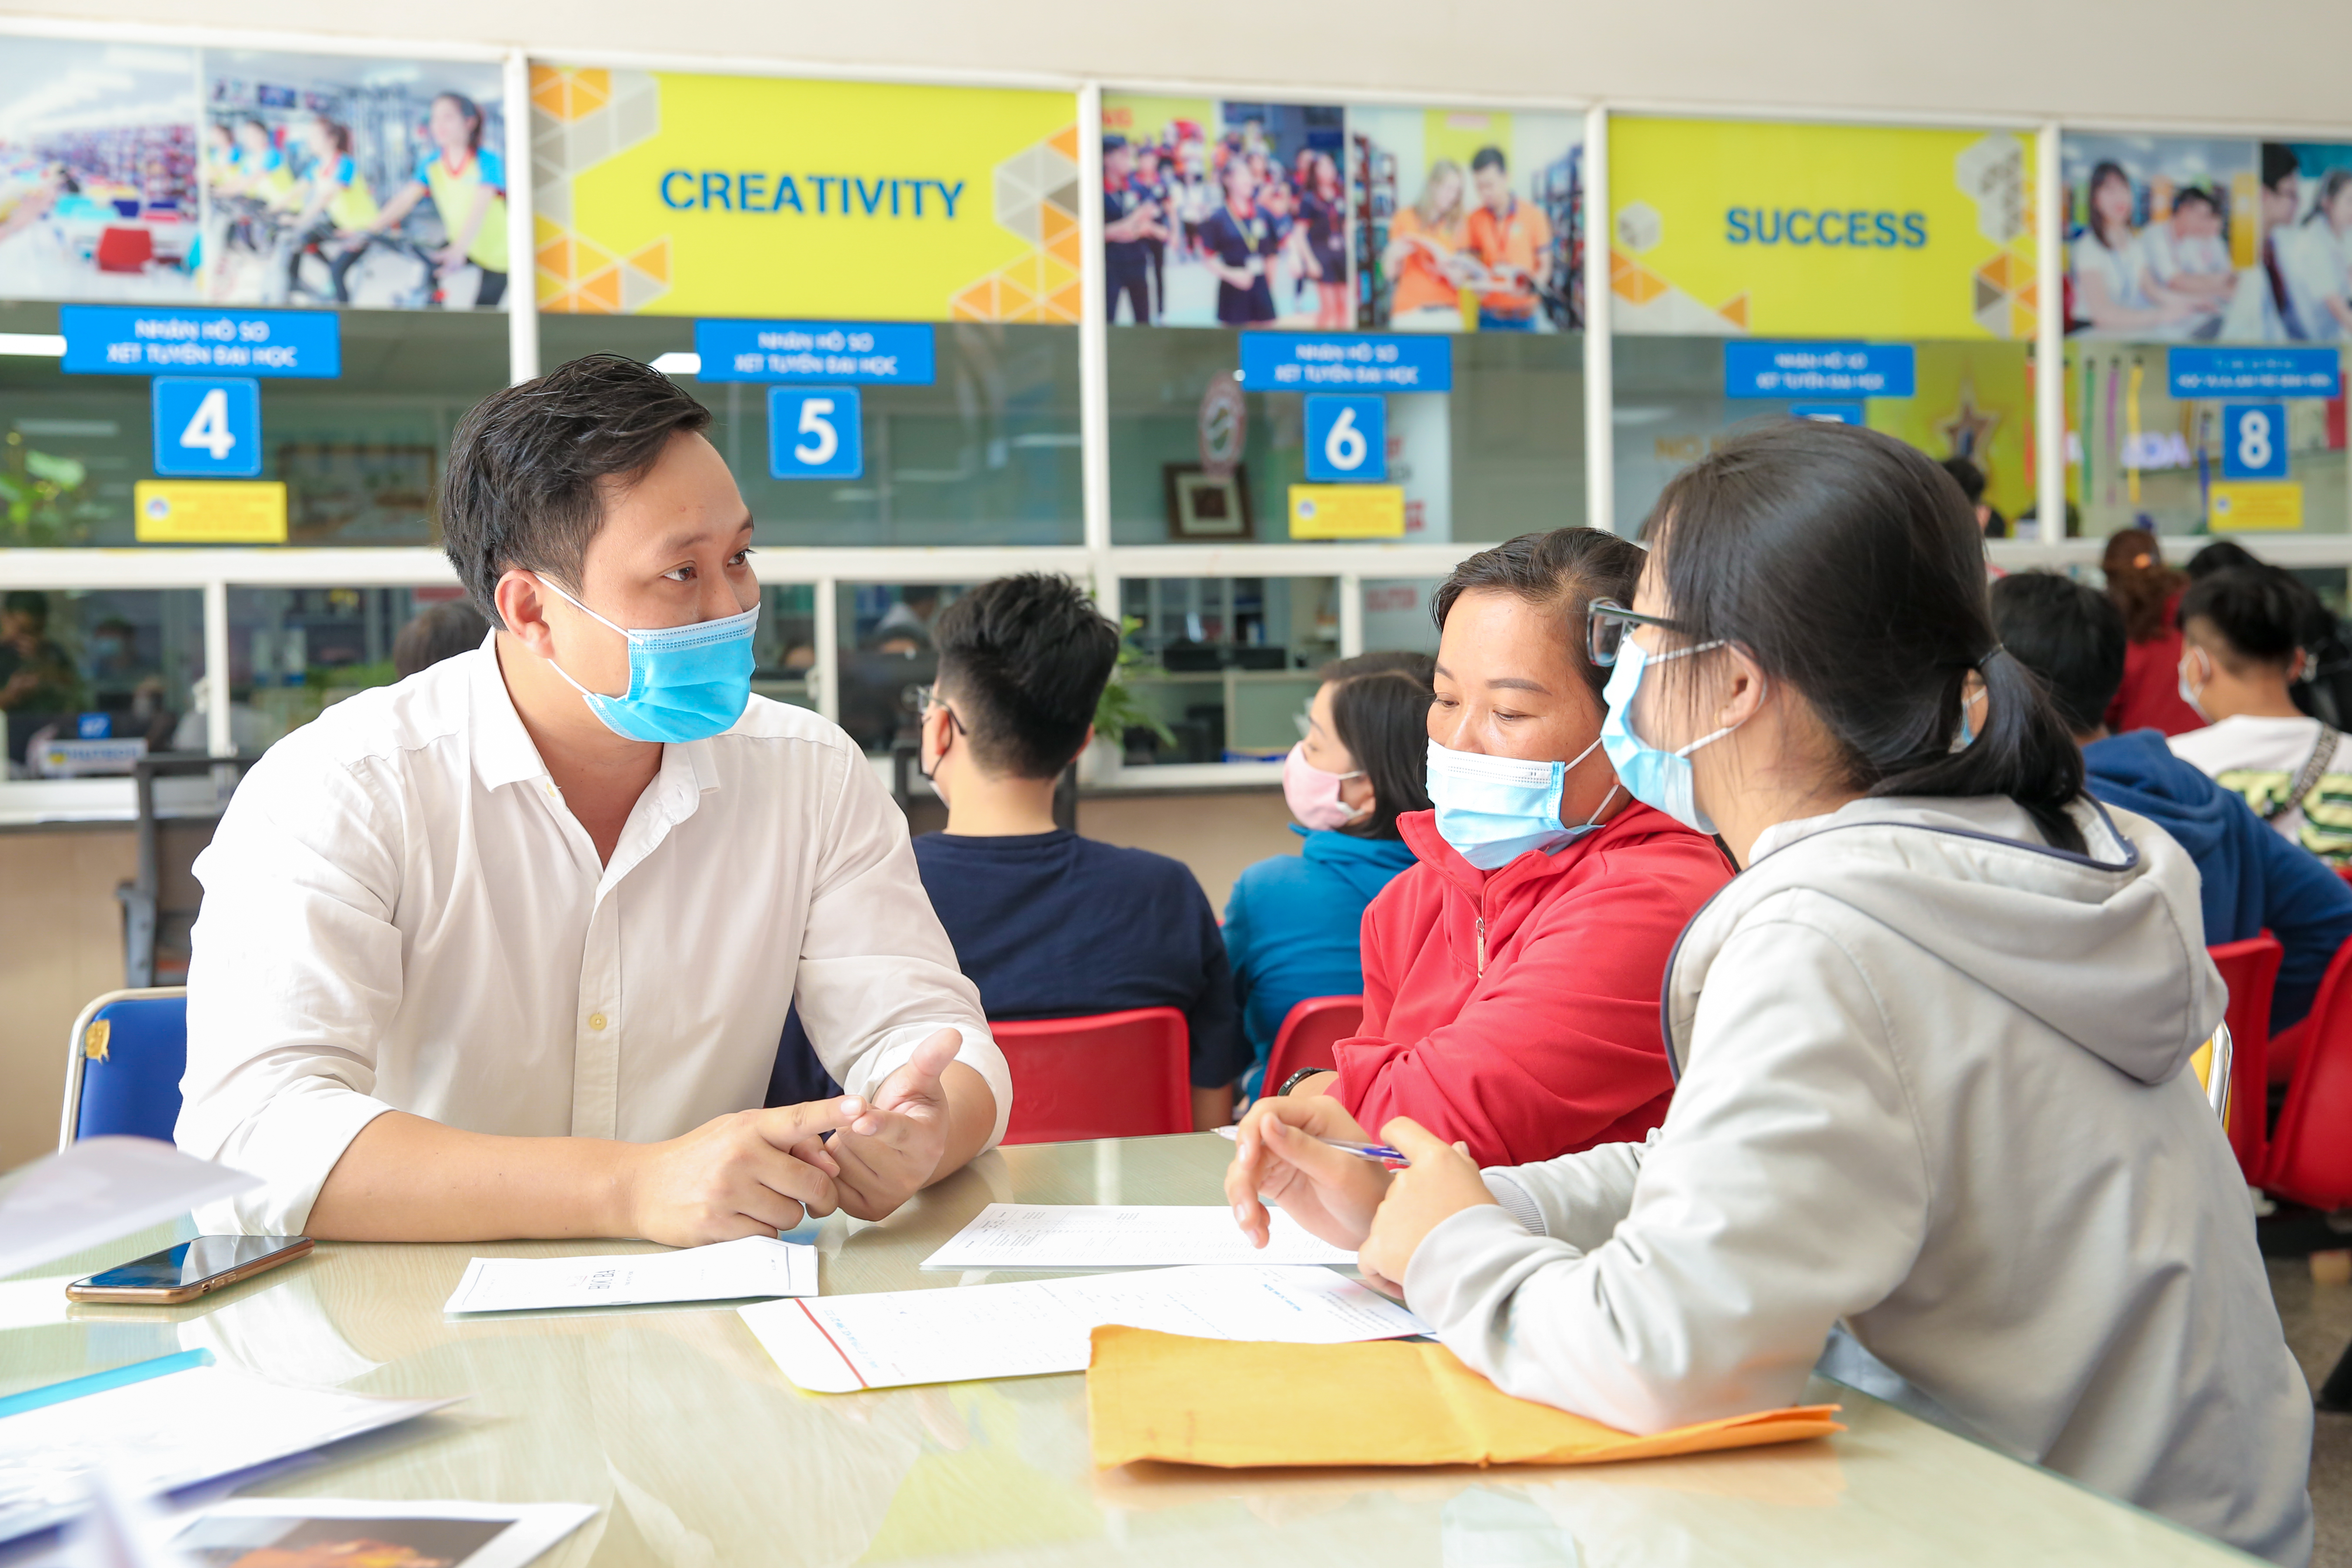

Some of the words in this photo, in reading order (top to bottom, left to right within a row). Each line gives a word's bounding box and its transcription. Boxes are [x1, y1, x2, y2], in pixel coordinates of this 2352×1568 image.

[660, 169, 965, 219] CREATIVITY
[1725, 206, 1929, 250] SUCCESS
[181, 389, 235, 459] 4
[795, 398, 837, 465] 5
[1325, 407, 1366, 470] 6
[2239, 410, 2271, 469] 8
